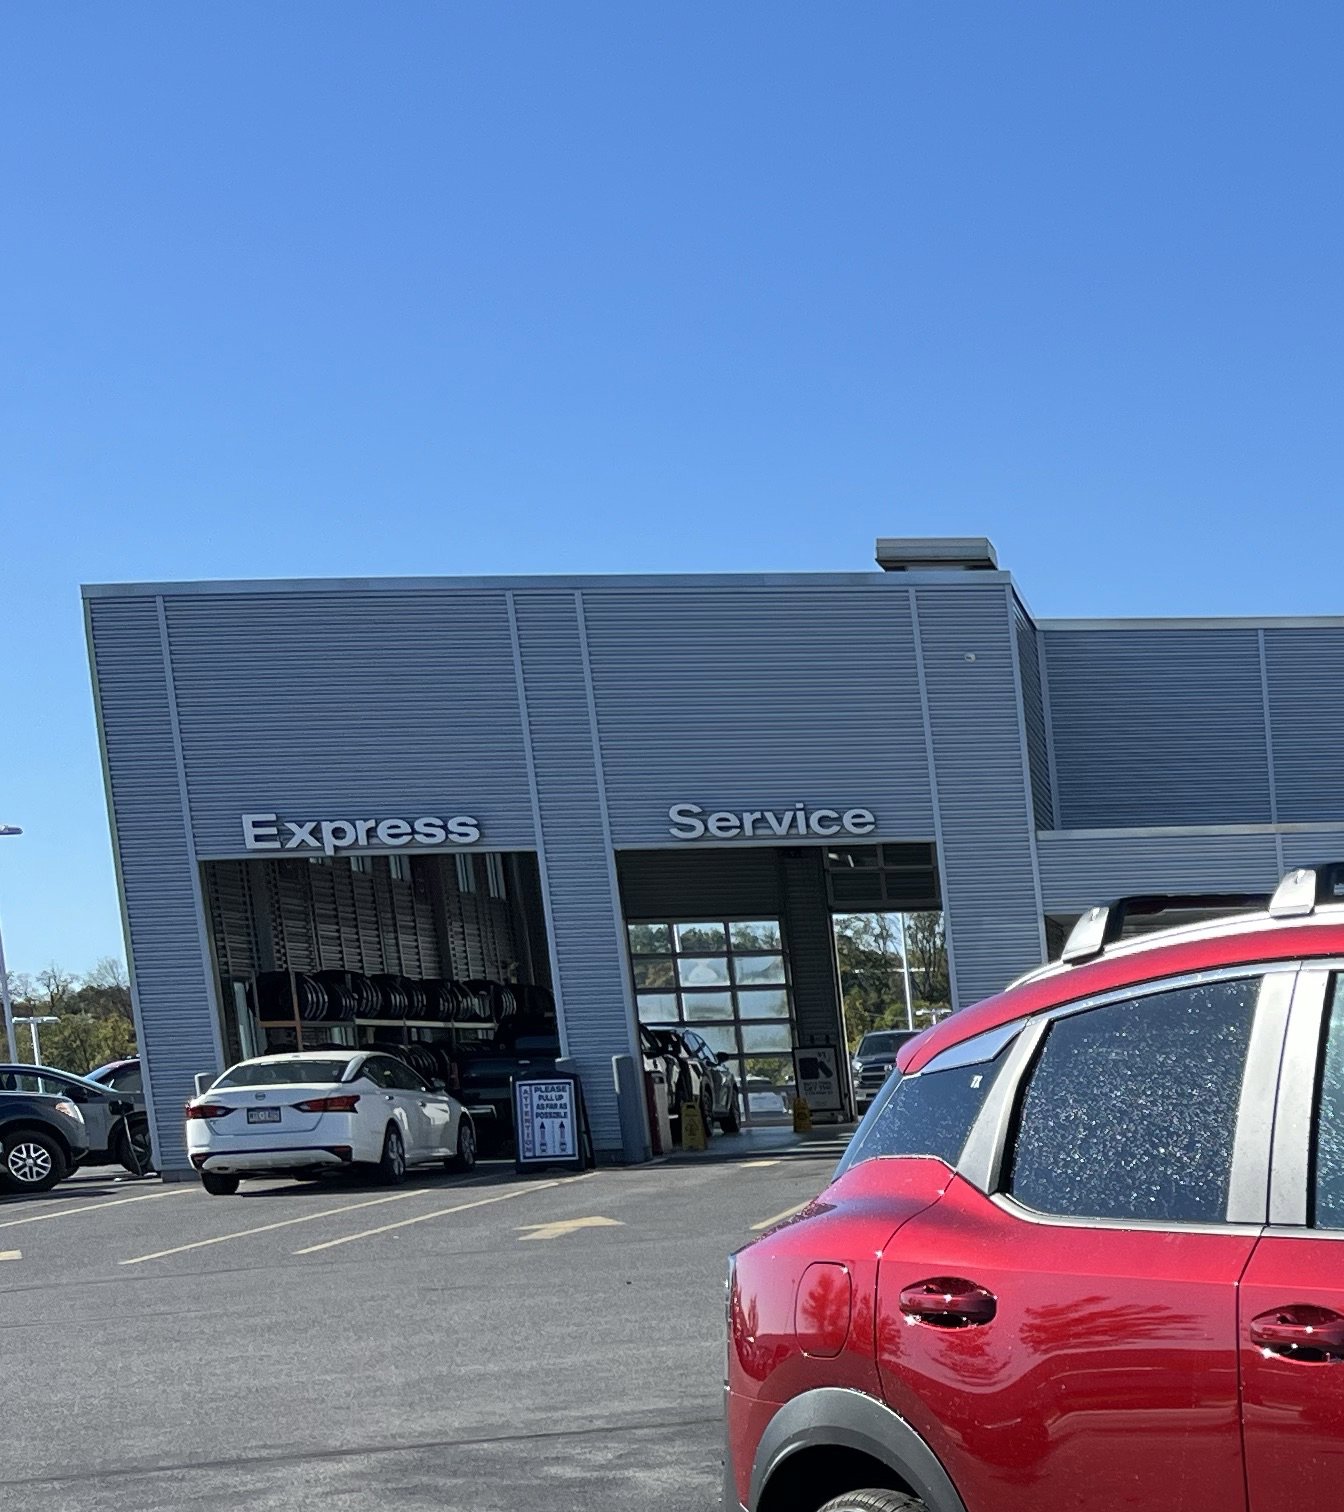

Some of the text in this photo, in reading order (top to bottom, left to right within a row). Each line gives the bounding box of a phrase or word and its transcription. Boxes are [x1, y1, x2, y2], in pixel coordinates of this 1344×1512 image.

[668, 802, 876, 839] Service
[241, 813, 481, 856] Express
[534, 1085, 567, 1093] PLEASE
[536, 1111, 568, 1119] POSSIBLE
